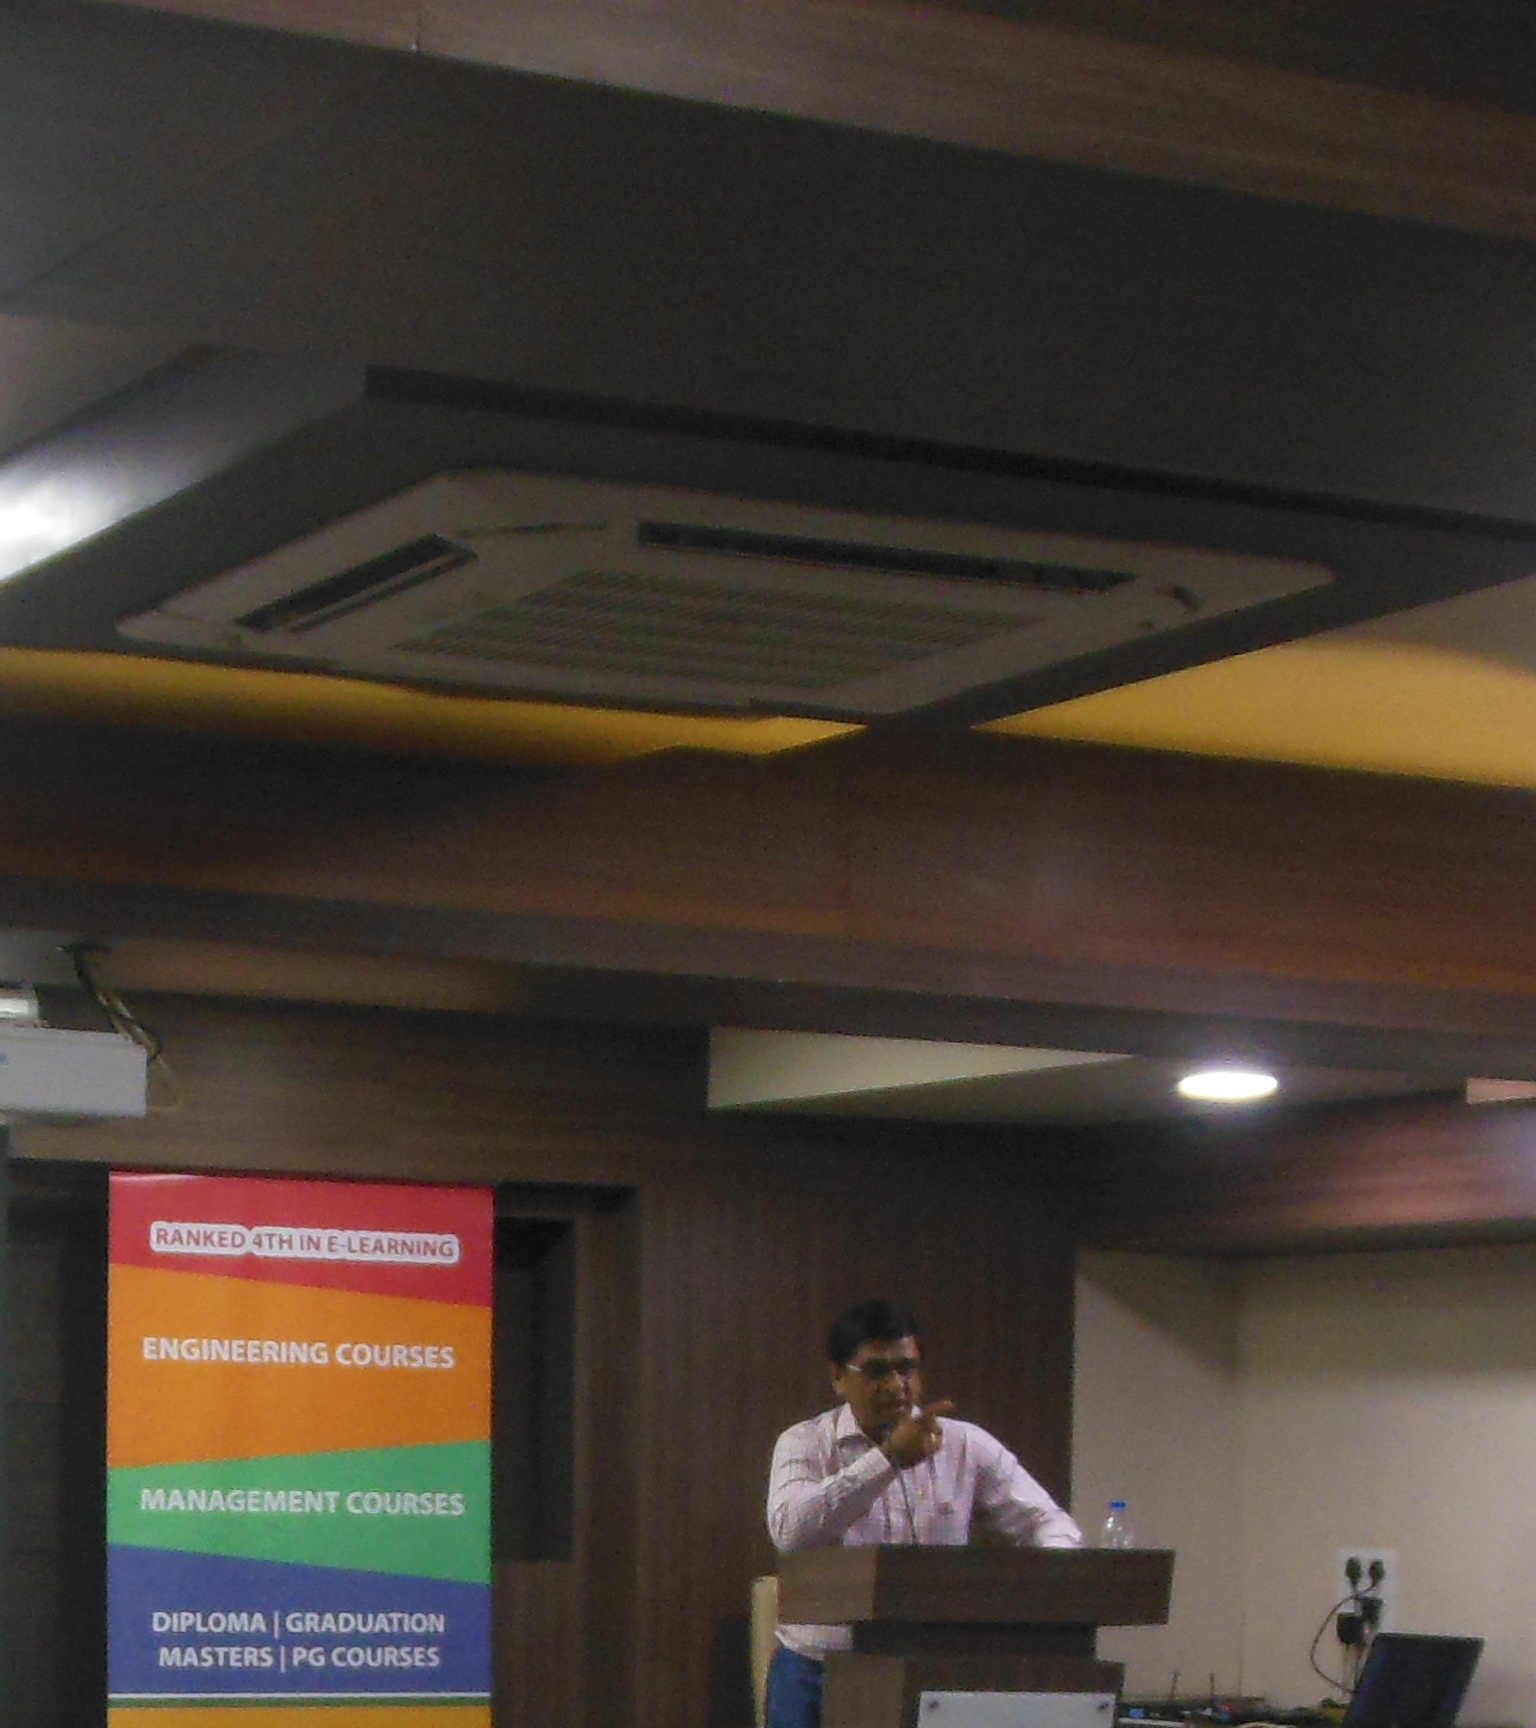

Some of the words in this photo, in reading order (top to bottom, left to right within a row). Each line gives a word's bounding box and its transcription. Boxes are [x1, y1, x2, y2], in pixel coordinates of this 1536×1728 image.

[156, 1228, 246, 1249] RANKED
[252, 1232, 293, 1251] 4TH
[300, 1234, 321, 1252] IN
[327, 1235, 454, 1258] E-LEARNING
[143, 1336, 329, 1365] ENGINEERING
[336, 1342, 456, 1369] COURSES
[140, 1487, 340, 1514] MANAGEMENT
[346, 1491, 465, 1516] COURSES
[152, 1611, 267, 1634] DIPLOMA
[285, 1611, 446, 1635] GRADUATION
[159, 1646, 274, 1668] MASTERS
[292, 1646, 325, 1668] PG
[331, 1646, 441, 1669] COURSES
